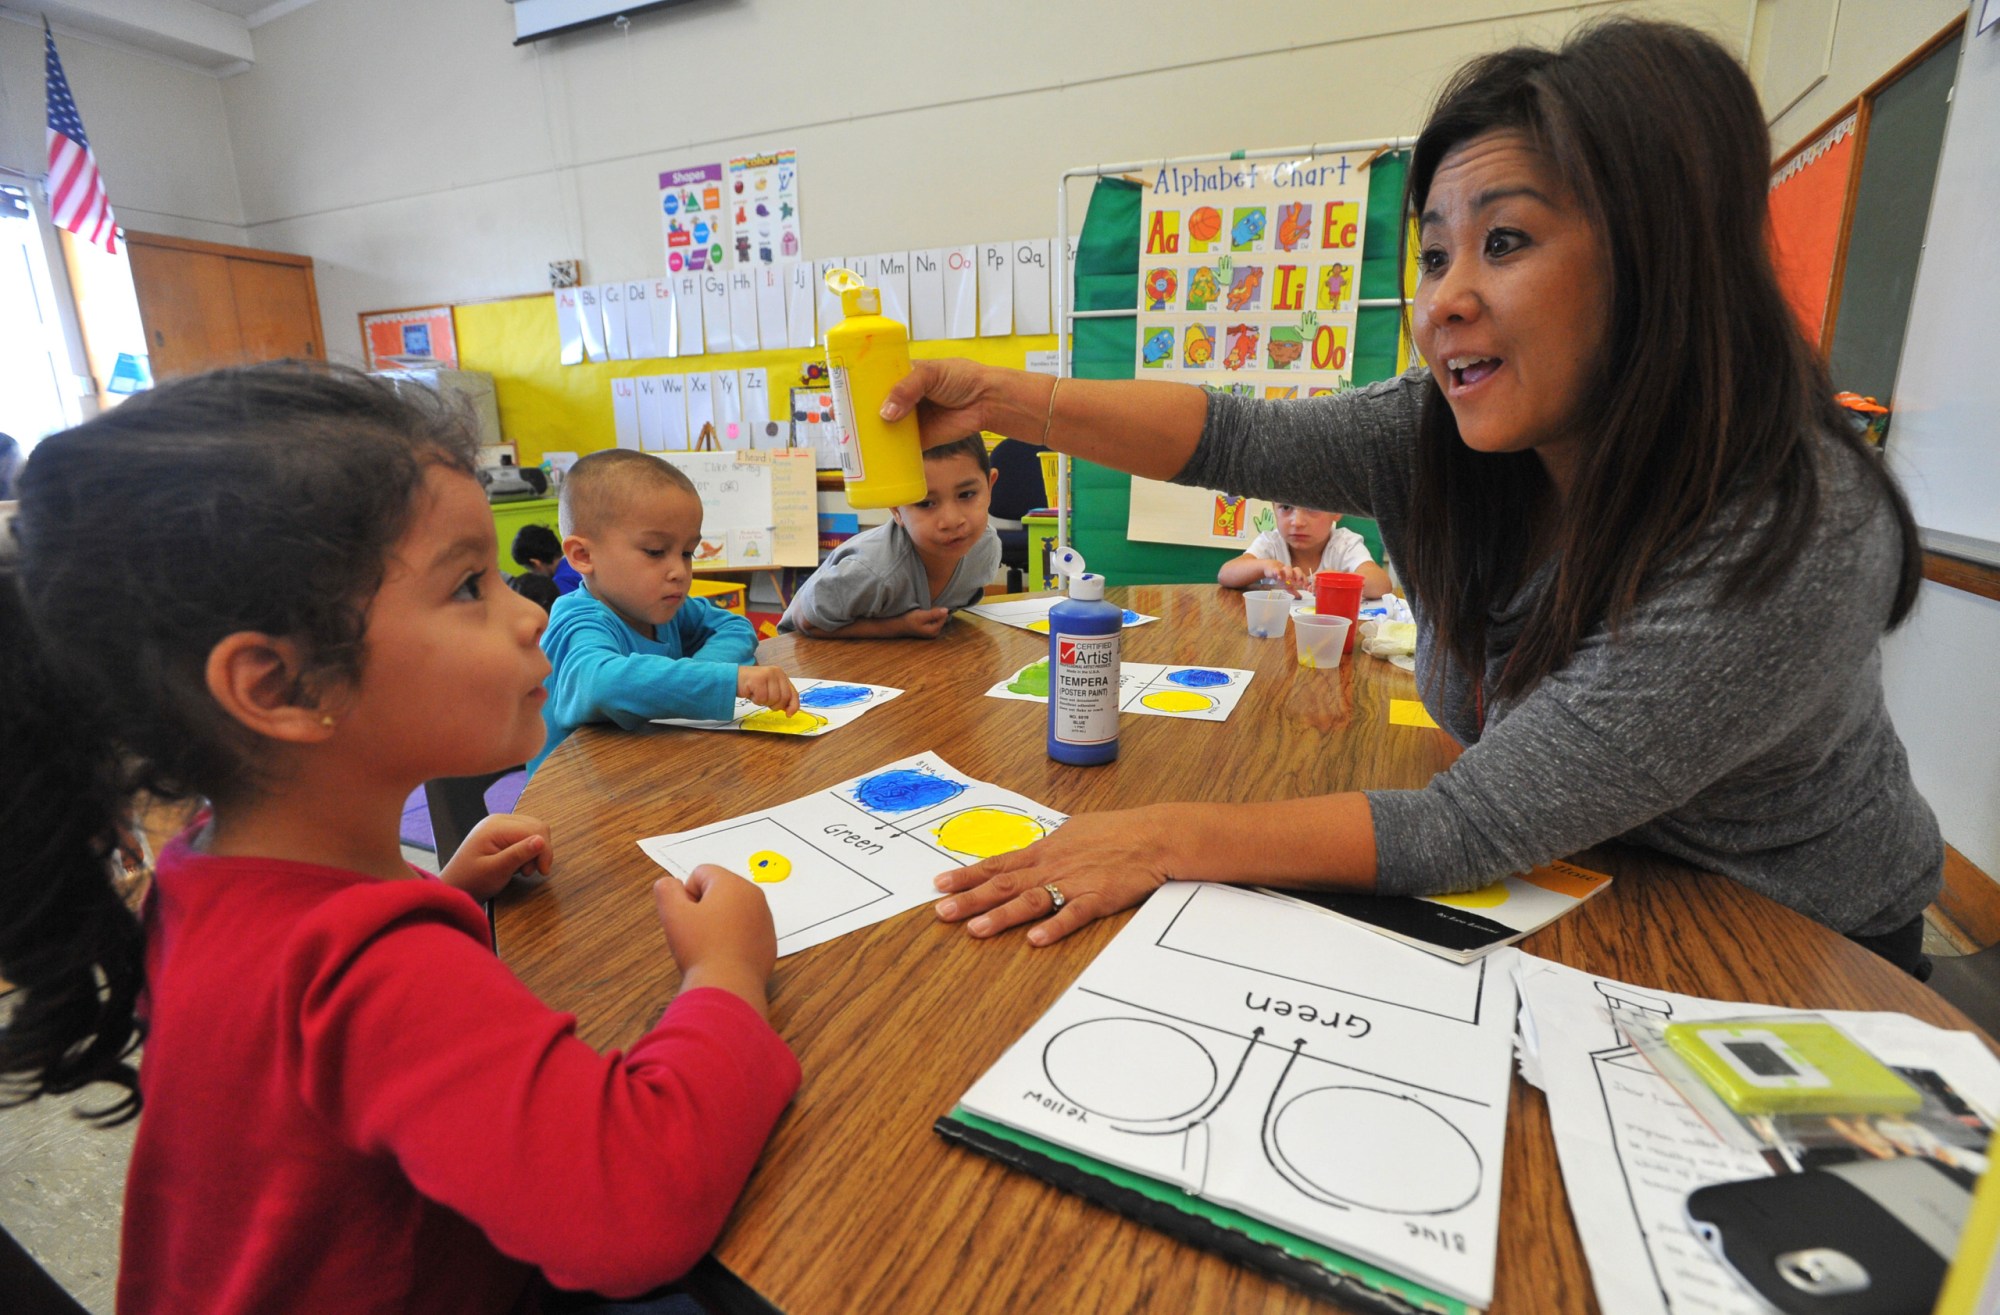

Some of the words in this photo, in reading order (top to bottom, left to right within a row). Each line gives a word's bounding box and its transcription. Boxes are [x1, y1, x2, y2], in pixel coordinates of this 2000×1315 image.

[672, 169, 705, 184] Shapes
[1154, 164, 1258, 196] Alphabet
[1272, 156, 1352, 188] Chart
[1146, 210, 1180, 254] Aa
[1321, 201, 1358, 250] Ee
[560, 295, 575, 307] Aa
[582, 291, 596, 306] Bb
[606, 288, 620, 302] Cc
[630, 284, 645, 300] Dd
[656, 284, 668, 298] Ee
[683, 279, 694, 296] Ff
[706, 277, 724, 296] Gg
[733, 273, 750, 290] Hh
[766, 271, 774, 287] Ii
[794, 268, 806, 288] Jj
[880, 258, 904, 274] Mm
[916, 256, 936, 272] Nn
[948, 252, 970, 270] Oo
[988, 249, 1004, 271] Pp
[1017, 246, 1045, 268] Qq
[1274, 265, 1304, 311] Ii
[1312, 325, 1346, 370] Oo
[616, 383, 632, 397] Uu
[642, 382, 654, 395] Vv
[662, 380, 682, 393] Ww
[692, 378, 706, 392] Xx
[720, 376, 732, 393] Yy
[746, 373, 762, 389] Zz
[745, 452, 766, 462] heard
[1076, 642, 1112, 650] CERTIFIED
[1076, 650, 1112, 664] Artist
[1060, 675, 1108, 687] TEMPERA
[1060, 687, 1086, 697] (POSTER
[1088, 688, 1108, 697] PAINT)
[916, 760, 937, 774] Blue
[824, 822, 884, 856] Green
[1246, 991, 1372, 1040] Green
[1023, 1089, 1089, 1124] Yellow
[1404, 1221, 1468, 1254] Blue
